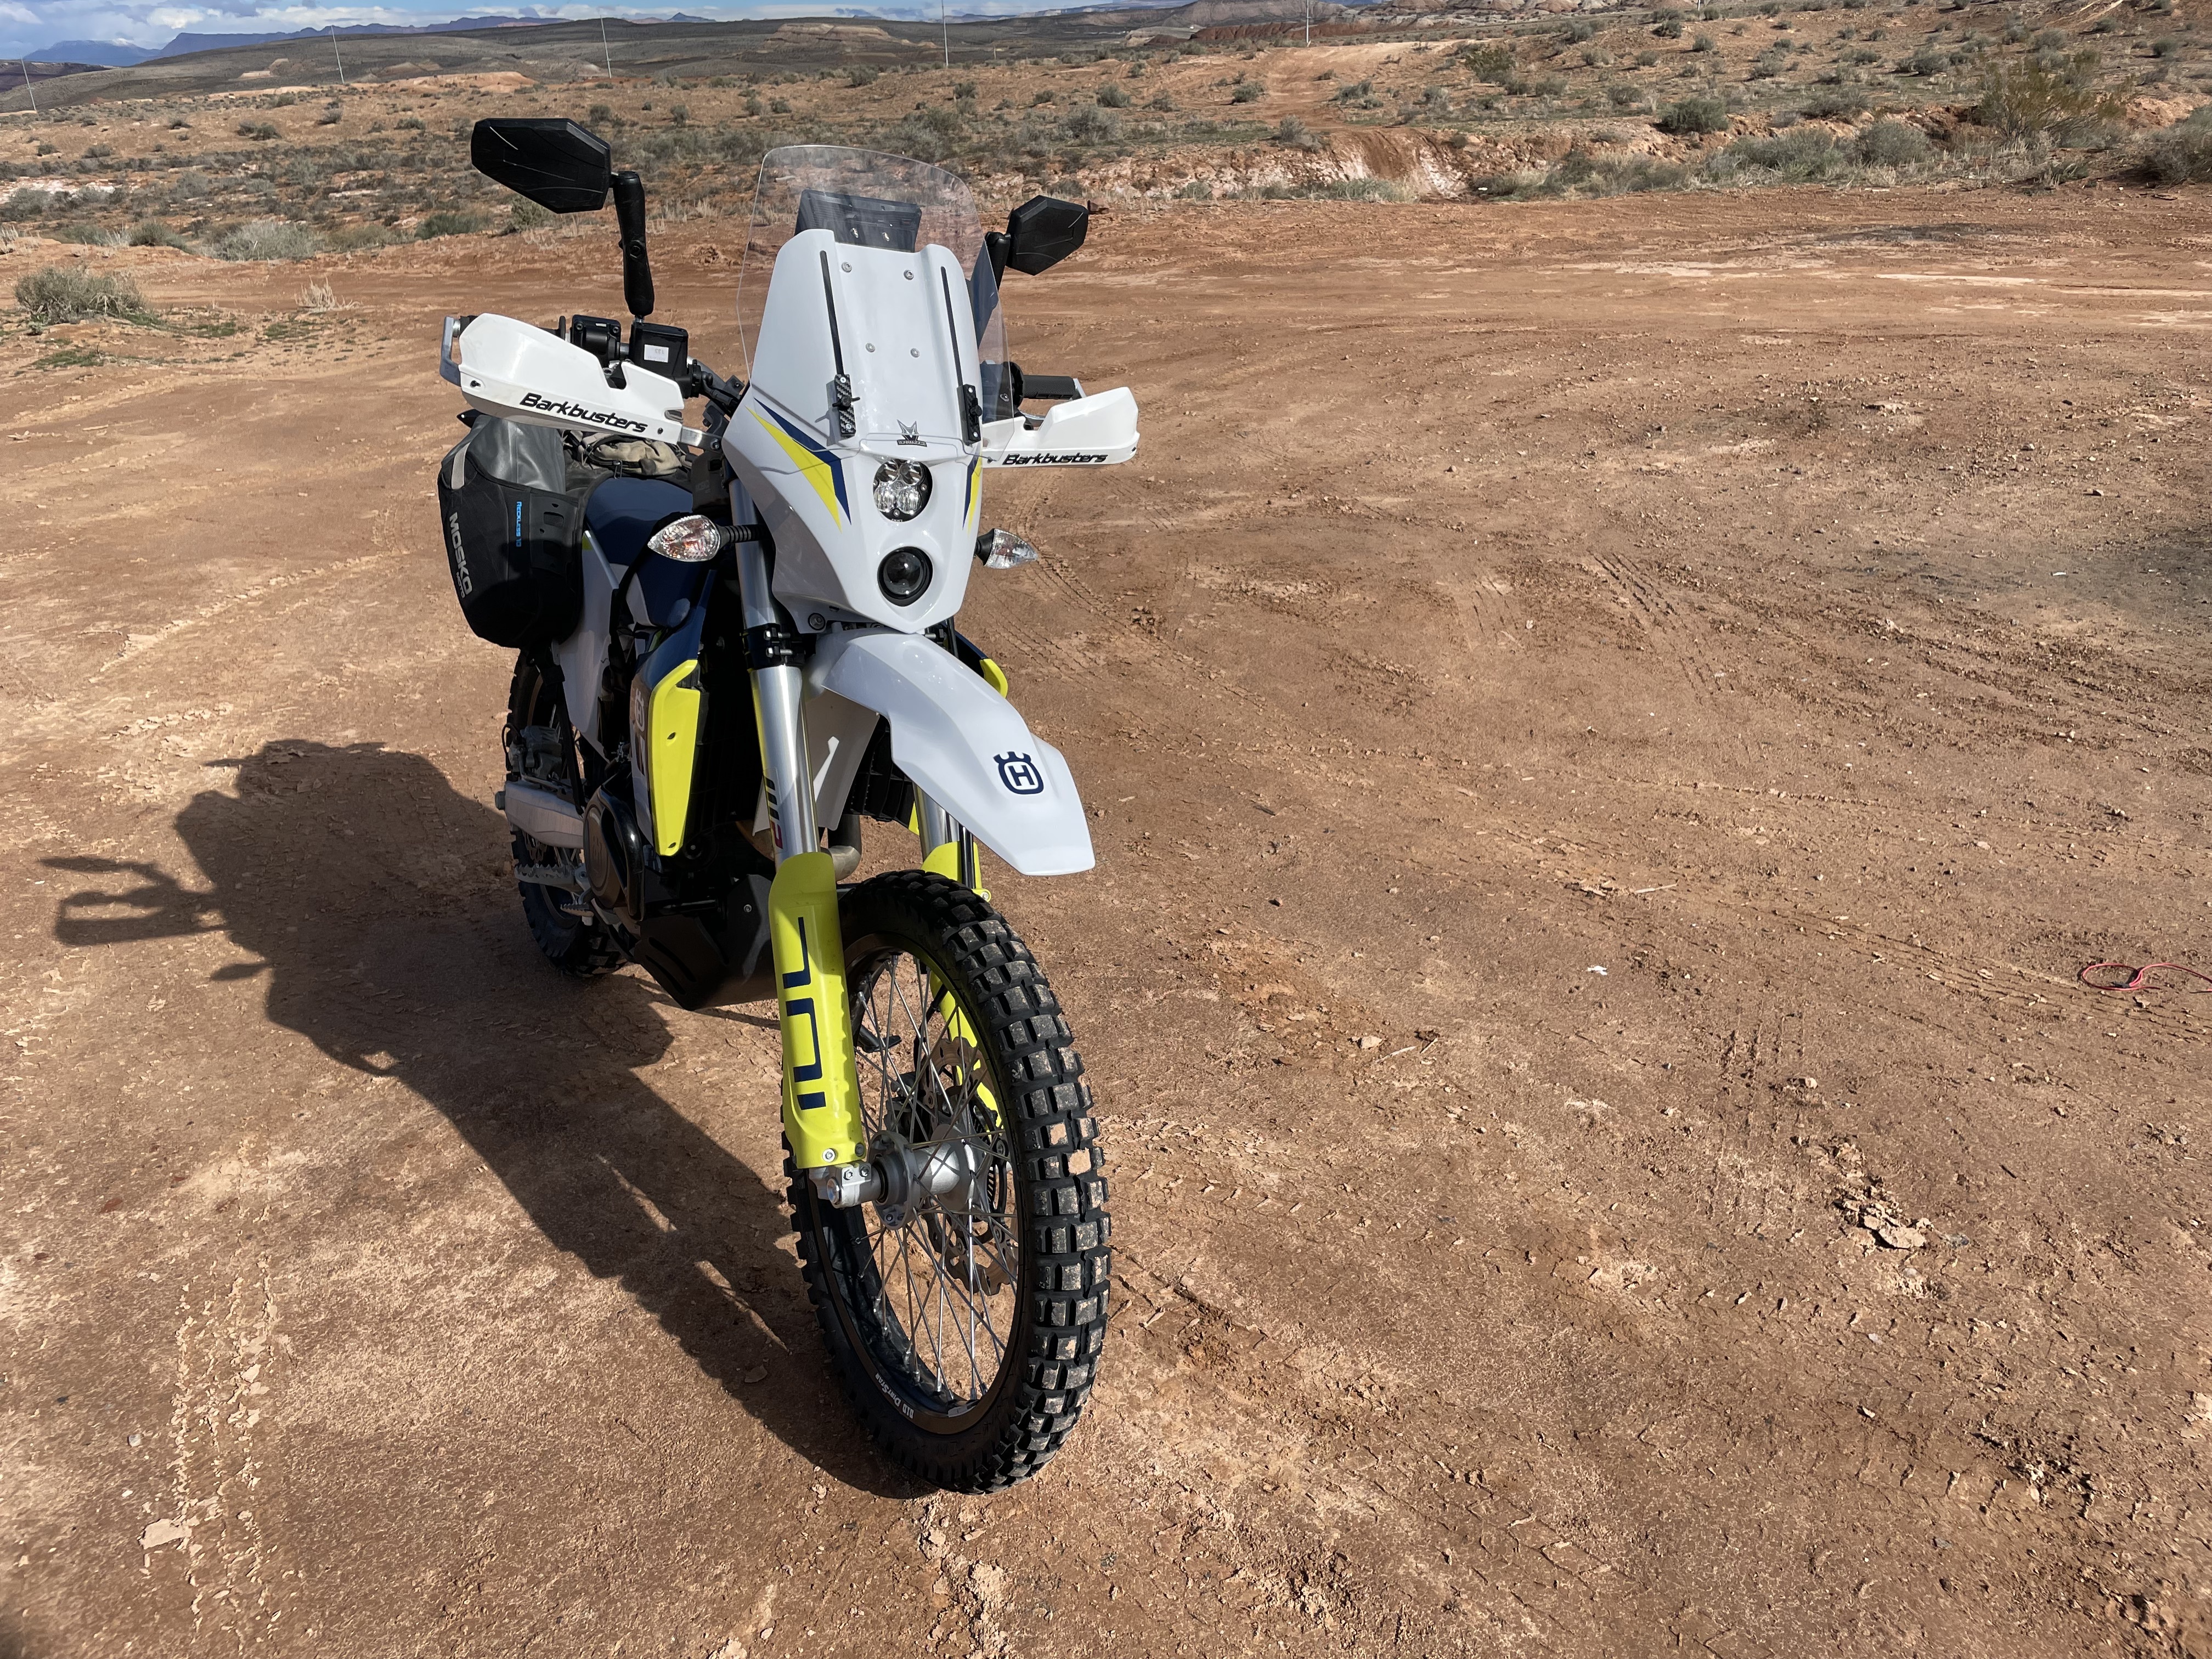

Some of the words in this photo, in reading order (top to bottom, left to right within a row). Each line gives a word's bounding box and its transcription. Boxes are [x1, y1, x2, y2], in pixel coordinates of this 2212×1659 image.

[519, 392, 648, 433] Barkbusters
[1002, 453, 1108, 465] Barkbusters
[449, 512, 472, 595] MOSKO
[902, 1403, 914, 1419] DID
